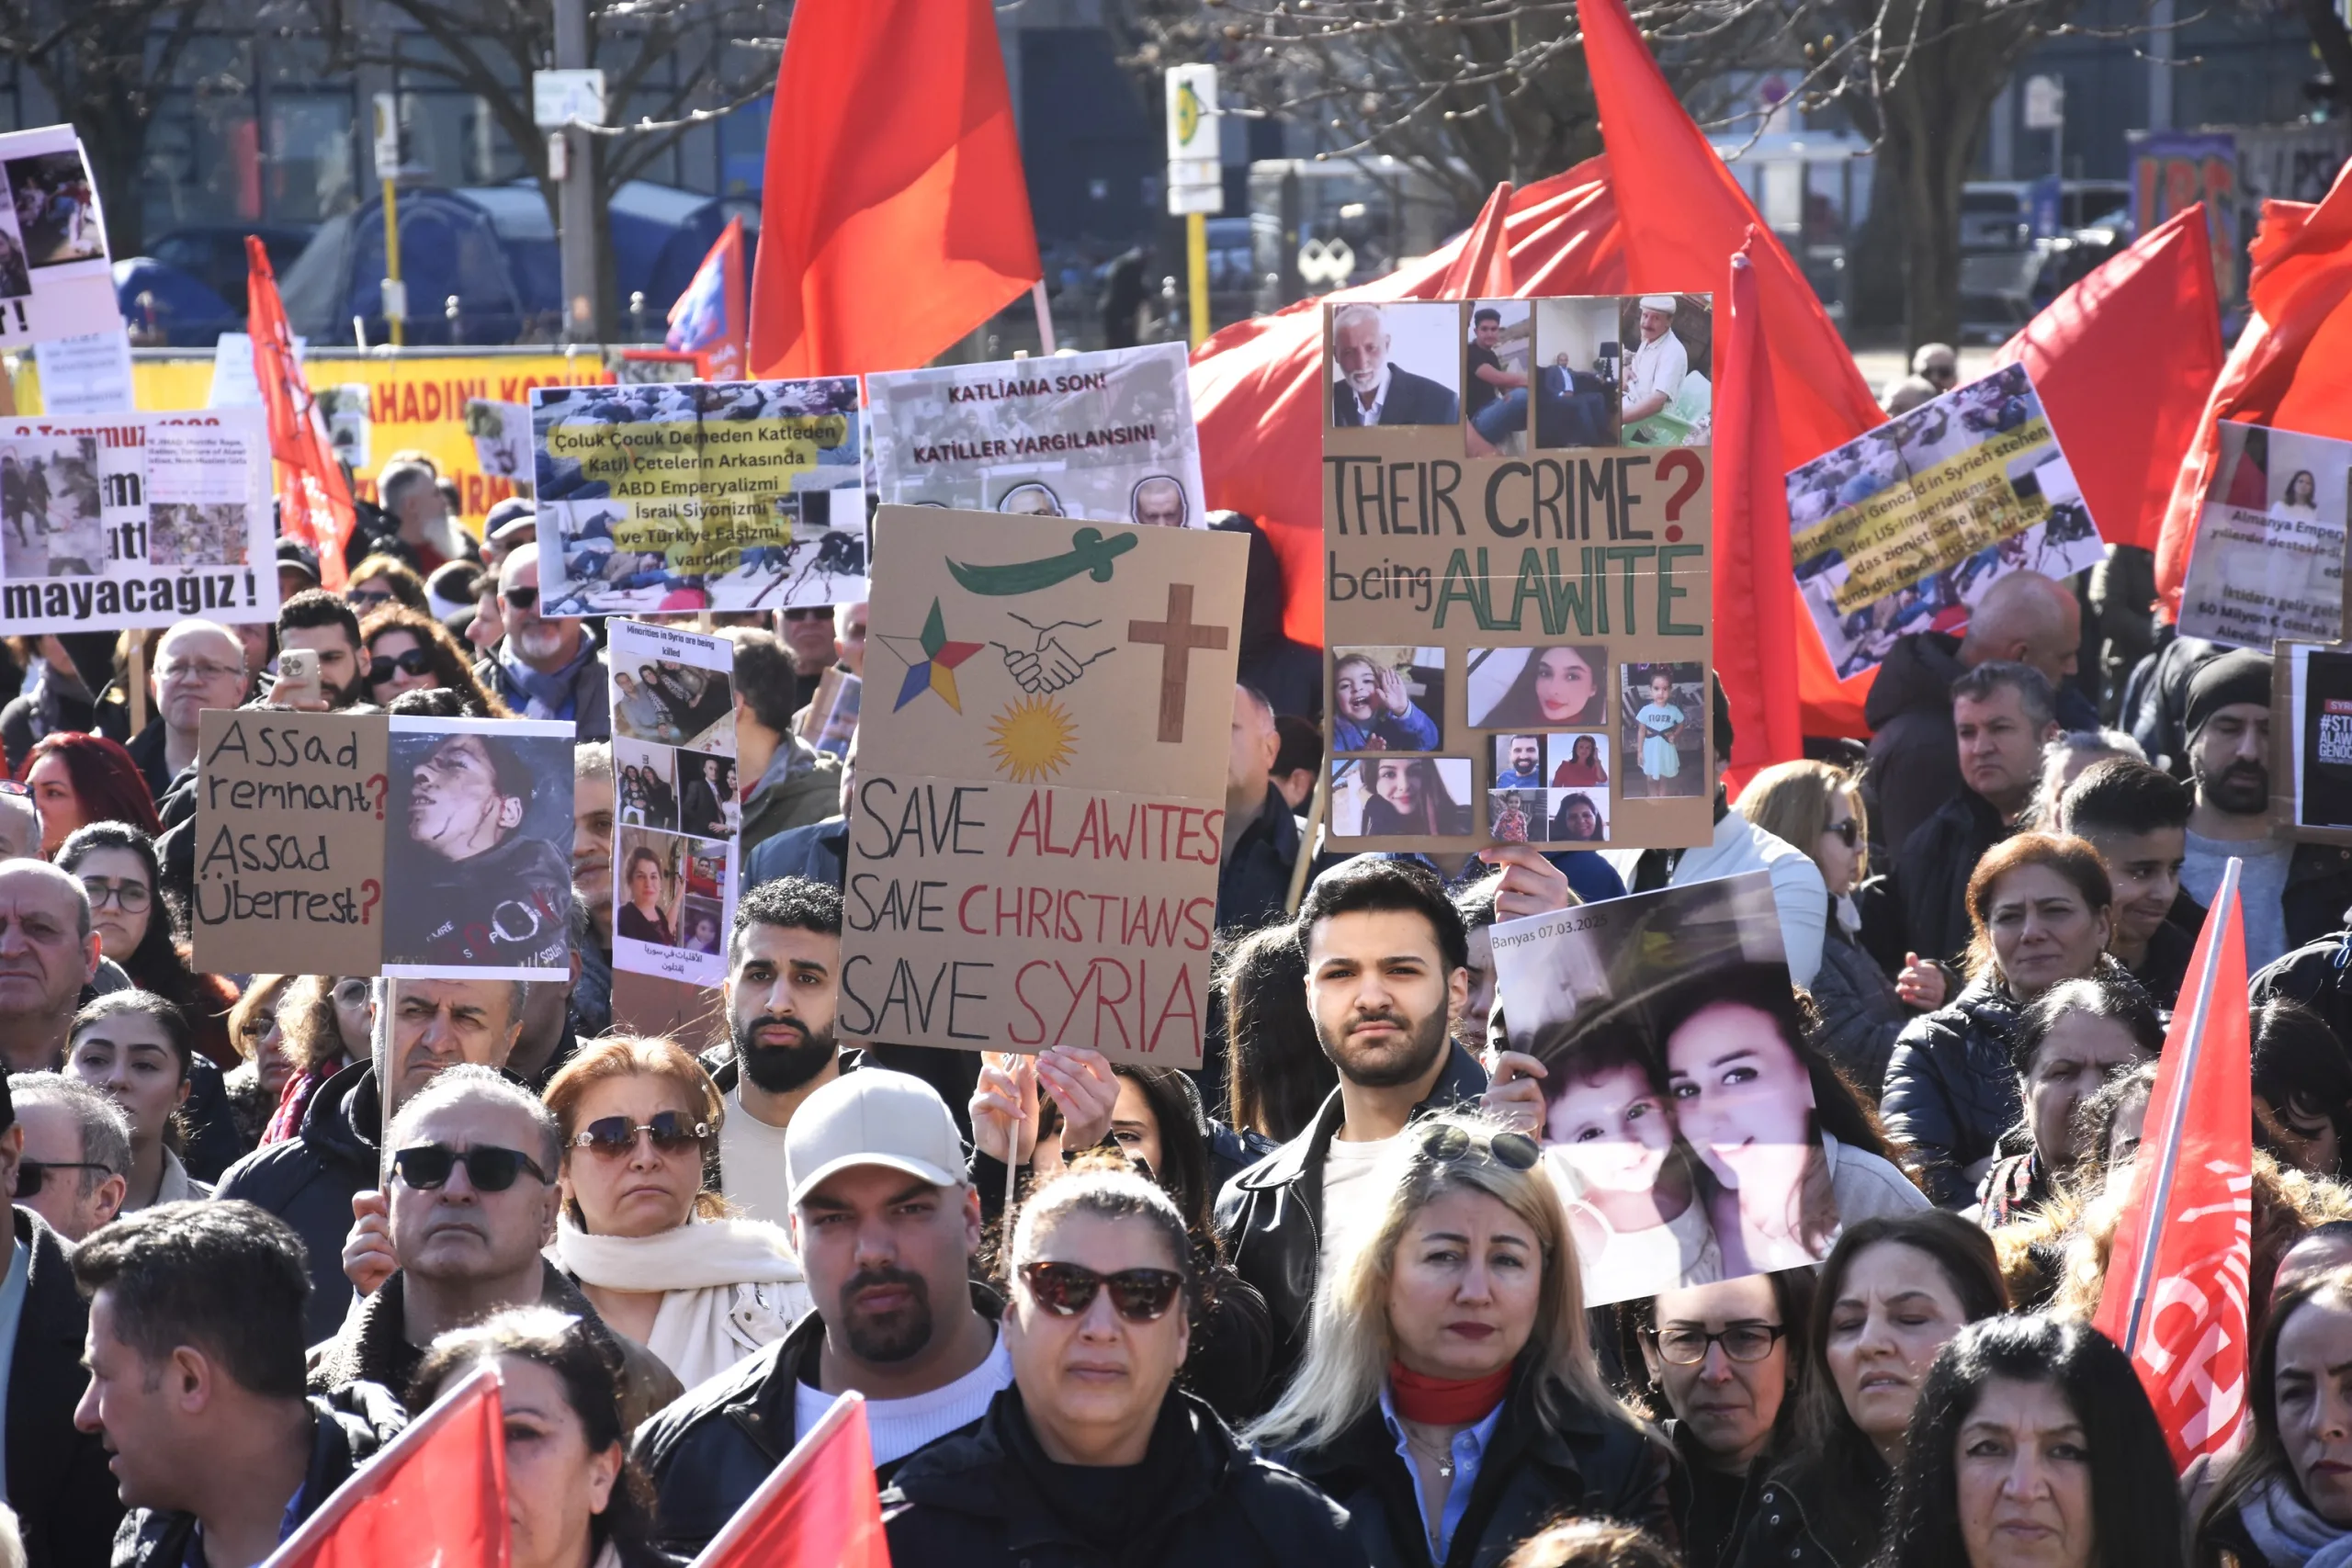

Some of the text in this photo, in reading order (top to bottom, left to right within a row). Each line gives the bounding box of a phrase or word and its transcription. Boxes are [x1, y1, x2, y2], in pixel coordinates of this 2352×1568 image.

[948, 371, 1107, 403] KATLİAMA SON!
[555, 423, 836, 450] Çoluk Çocuk Demeden Katleden
[913, 423, 1157, 463] KATİLLER YARGILANSIN!
[589, 452, 805, 474] Katil Çetelerin Arkasında
[1929, 474, 1944, 490] in
[1944, 450, 1993, 485] Syrien
[1994, 425, 2050, 457] stehen
[616, 477, 778, 498] ABD Emperyalizmi
[1323, 455, 1466, 536] THEIR
[683, 500, 768, 521] Siyonizmi
[2232, 510, 2292, 532] Almanya
[620, 525, 780, 545] ve Türkiye Faşizmi
[1849, 536, 1871, 557] der
[1854, 555, 1882, 576] das
[3, 567, 236, 621] mayacağız
[1329, 544, 1704, 637] being ALAWITE
[2221, 604, 2267, 625] Milyon
[627, 625, 715, 650] Minorities in Syria are being
[662, 646, 681, 658] killed
[206, 719, 358, 770] Assad
[208, 773, 390, 820] remnant?
[855, 777, 1224, 865] SAVE ALAWITES
[199, 824, 331, 874] Assad
[193, 872, 382, 926] Überrest?
[847, 873, 1215, 952] SAVE CHRISTIANS
[1491, 913, 1609, 950] Banyas 07.03.2025
[644, 943, 663, 956] سوريا
[675, 950, 703, 963] الأقليات
[840, 954, 1203, 1058] SAVE SYRIA
